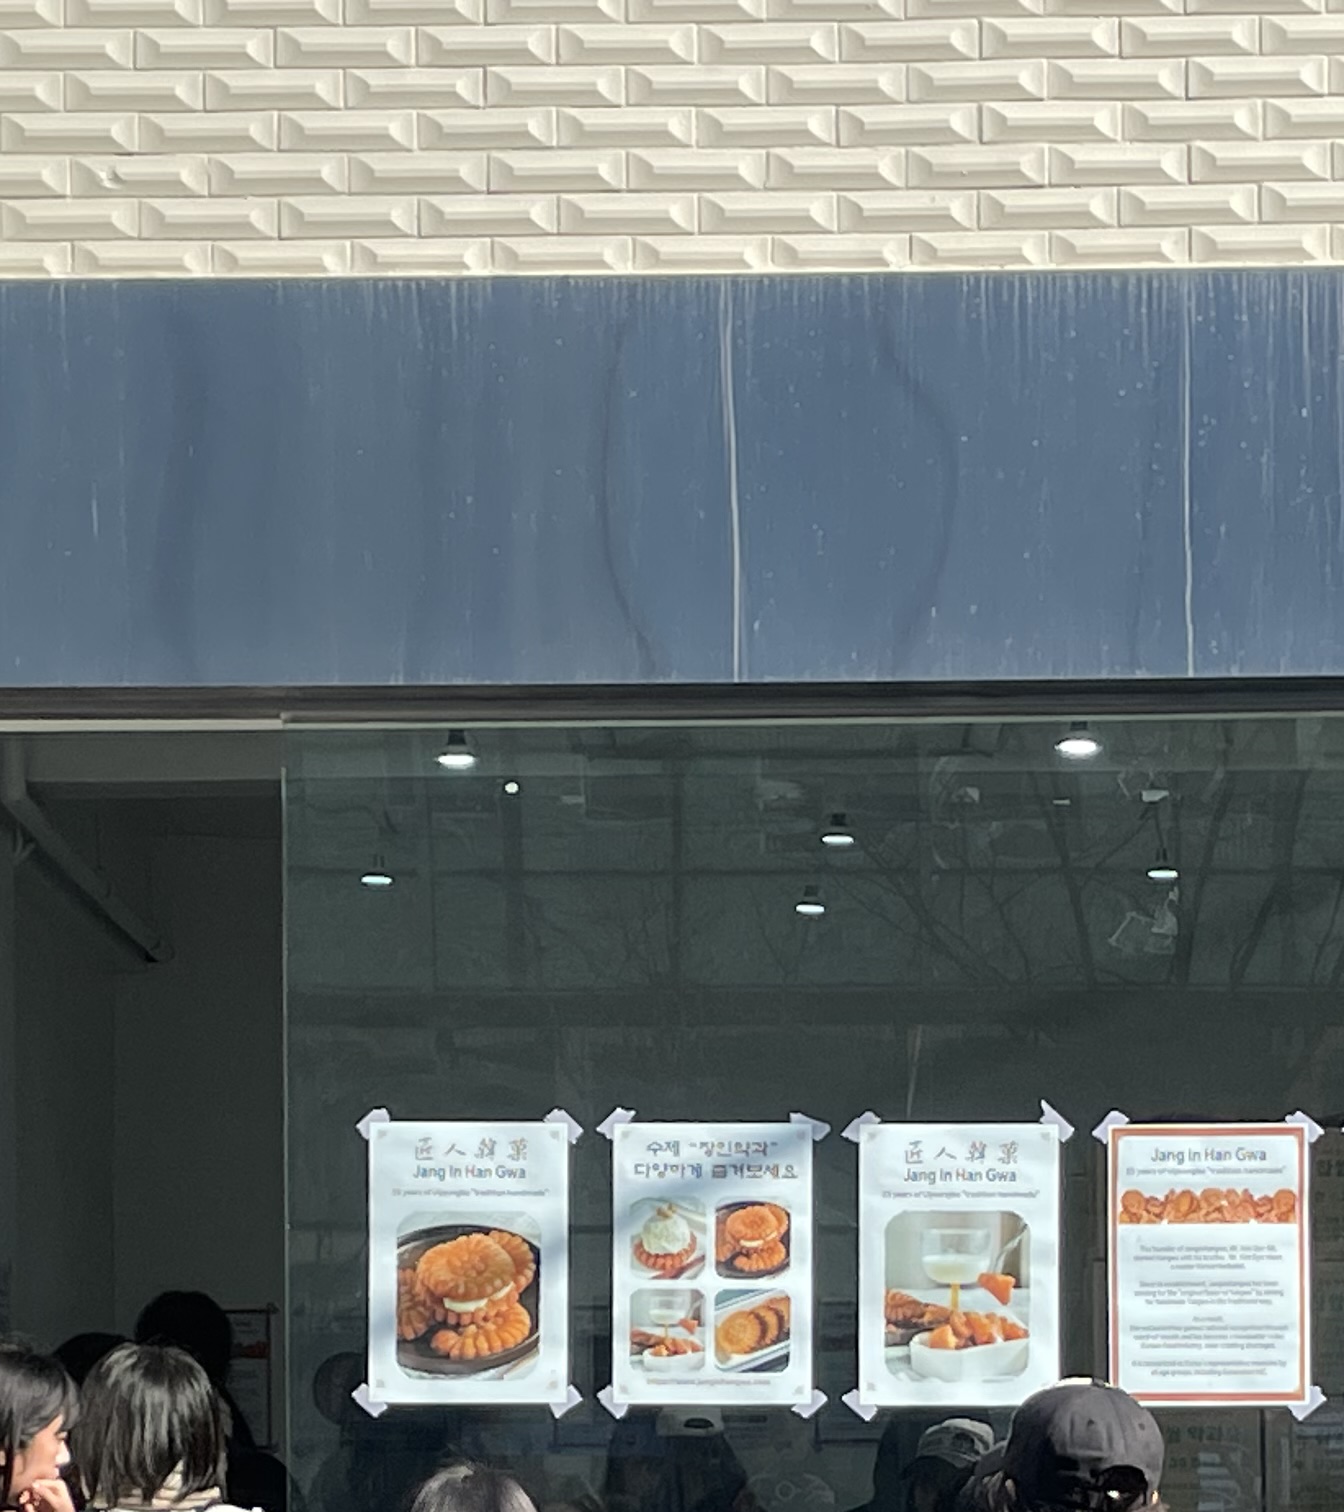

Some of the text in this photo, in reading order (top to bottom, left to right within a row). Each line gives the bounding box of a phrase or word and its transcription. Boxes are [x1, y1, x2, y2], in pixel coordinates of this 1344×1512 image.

[647, 1140, 680, 1157] 수제
[1151, 1147, 1267, 1165] Jang In Han Gwa
[413, 1165, 526, 1181] Jang In Han Gwa
[634, 1163, 702, 1178] 다양하게
[904, 1168, 1016, 1185] Jang In Han Gwa
